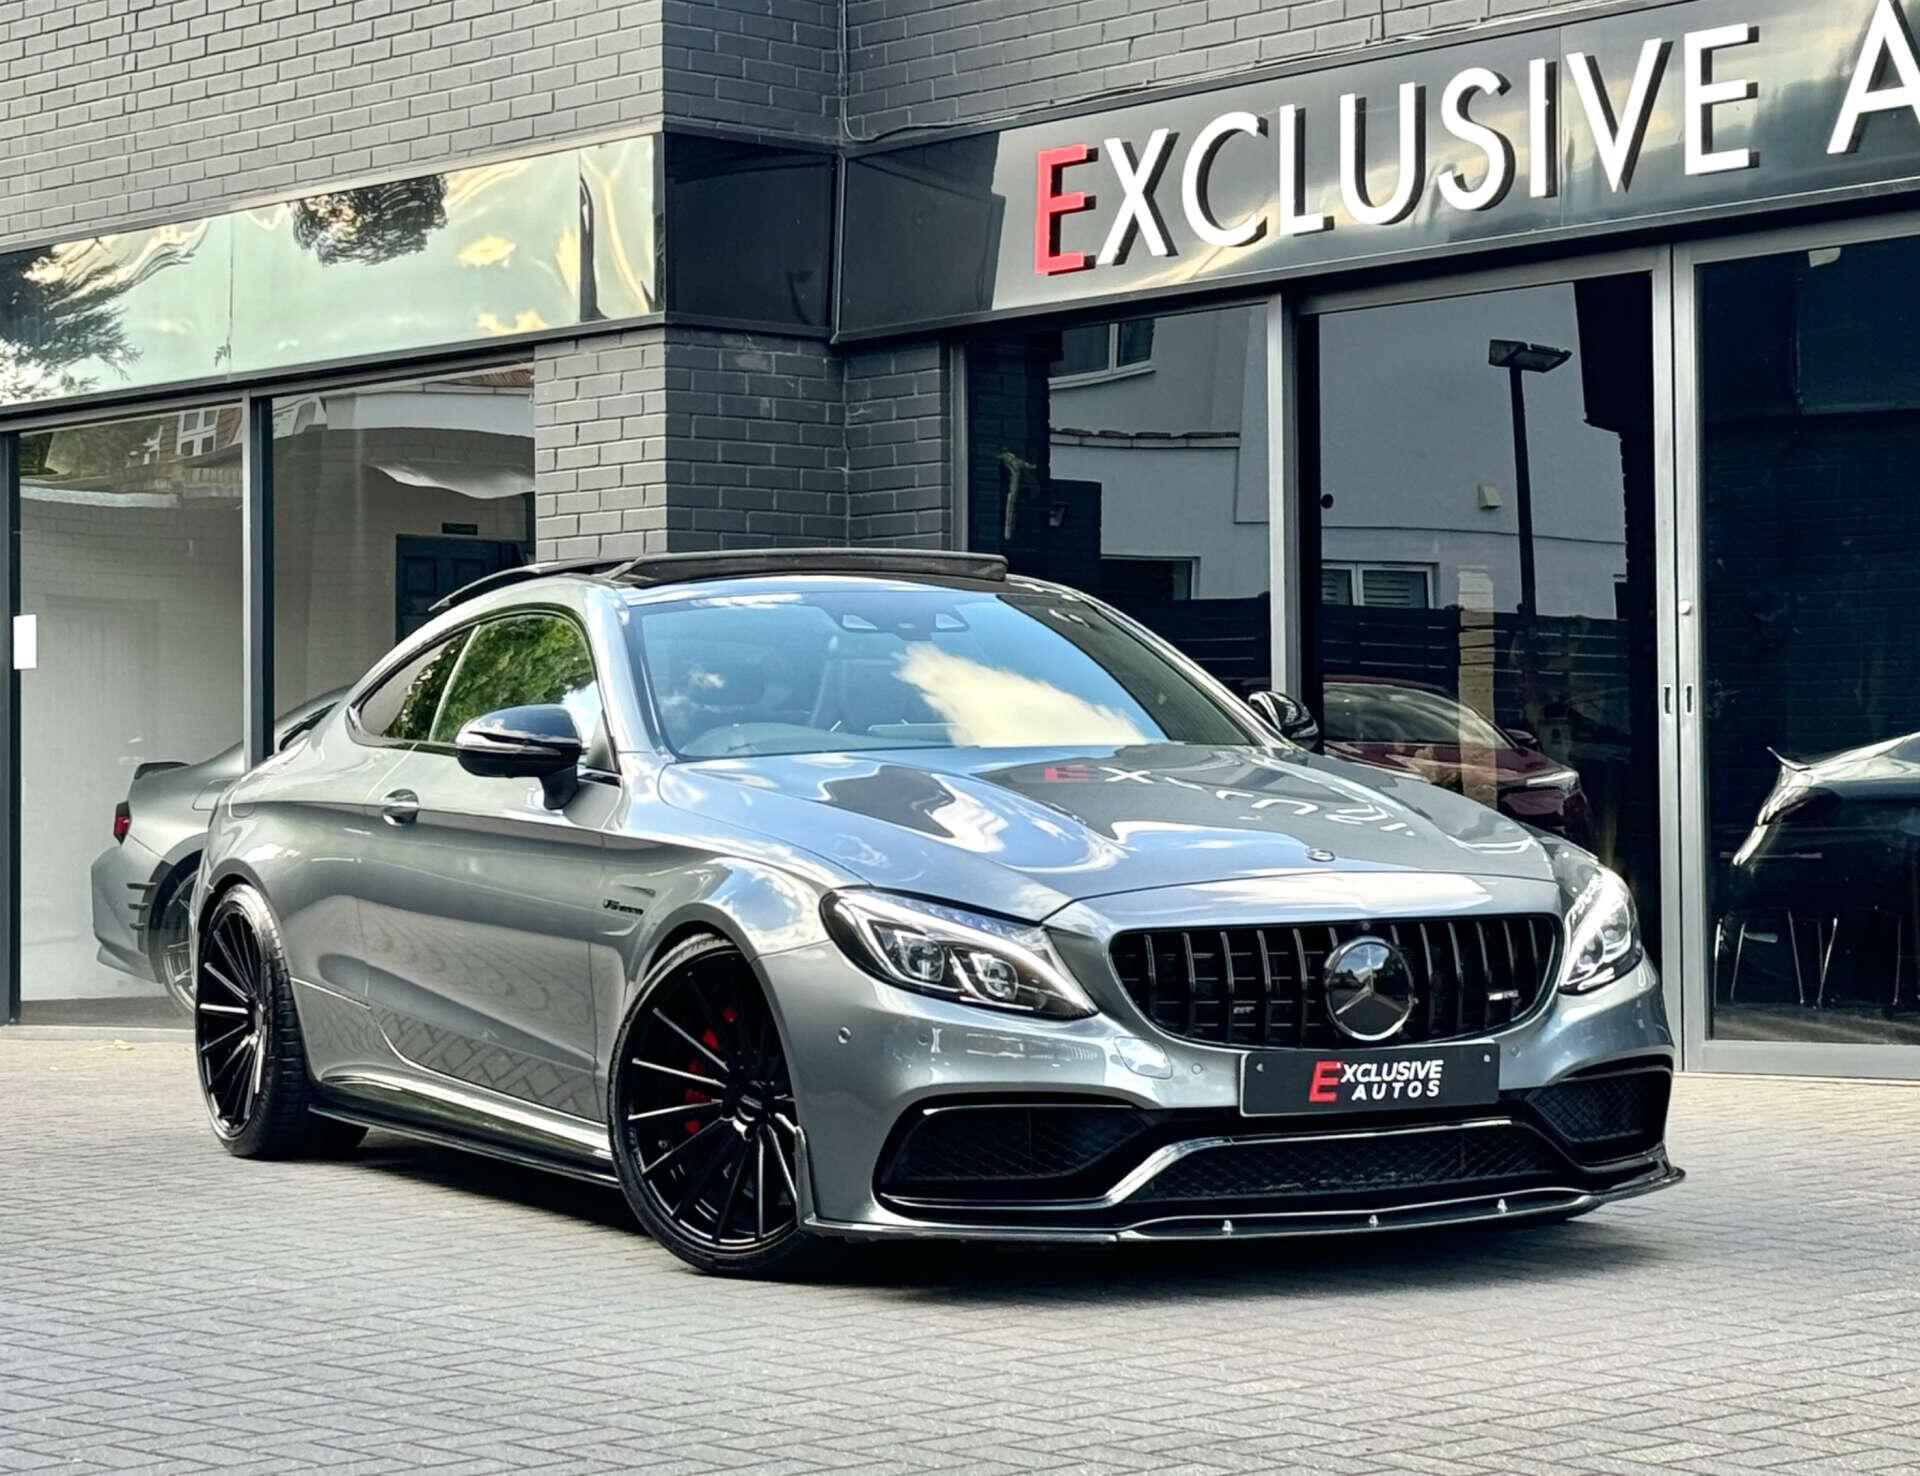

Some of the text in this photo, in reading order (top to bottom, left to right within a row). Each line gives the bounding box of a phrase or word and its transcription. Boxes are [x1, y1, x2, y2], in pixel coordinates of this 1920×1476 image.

[1034, 22, 1758, 276] EXCLUSIVE
[1309, 1060, 1444, 1103] EXCLUSIVE
[1351, 1080, 1440, 1101] AUTOS
